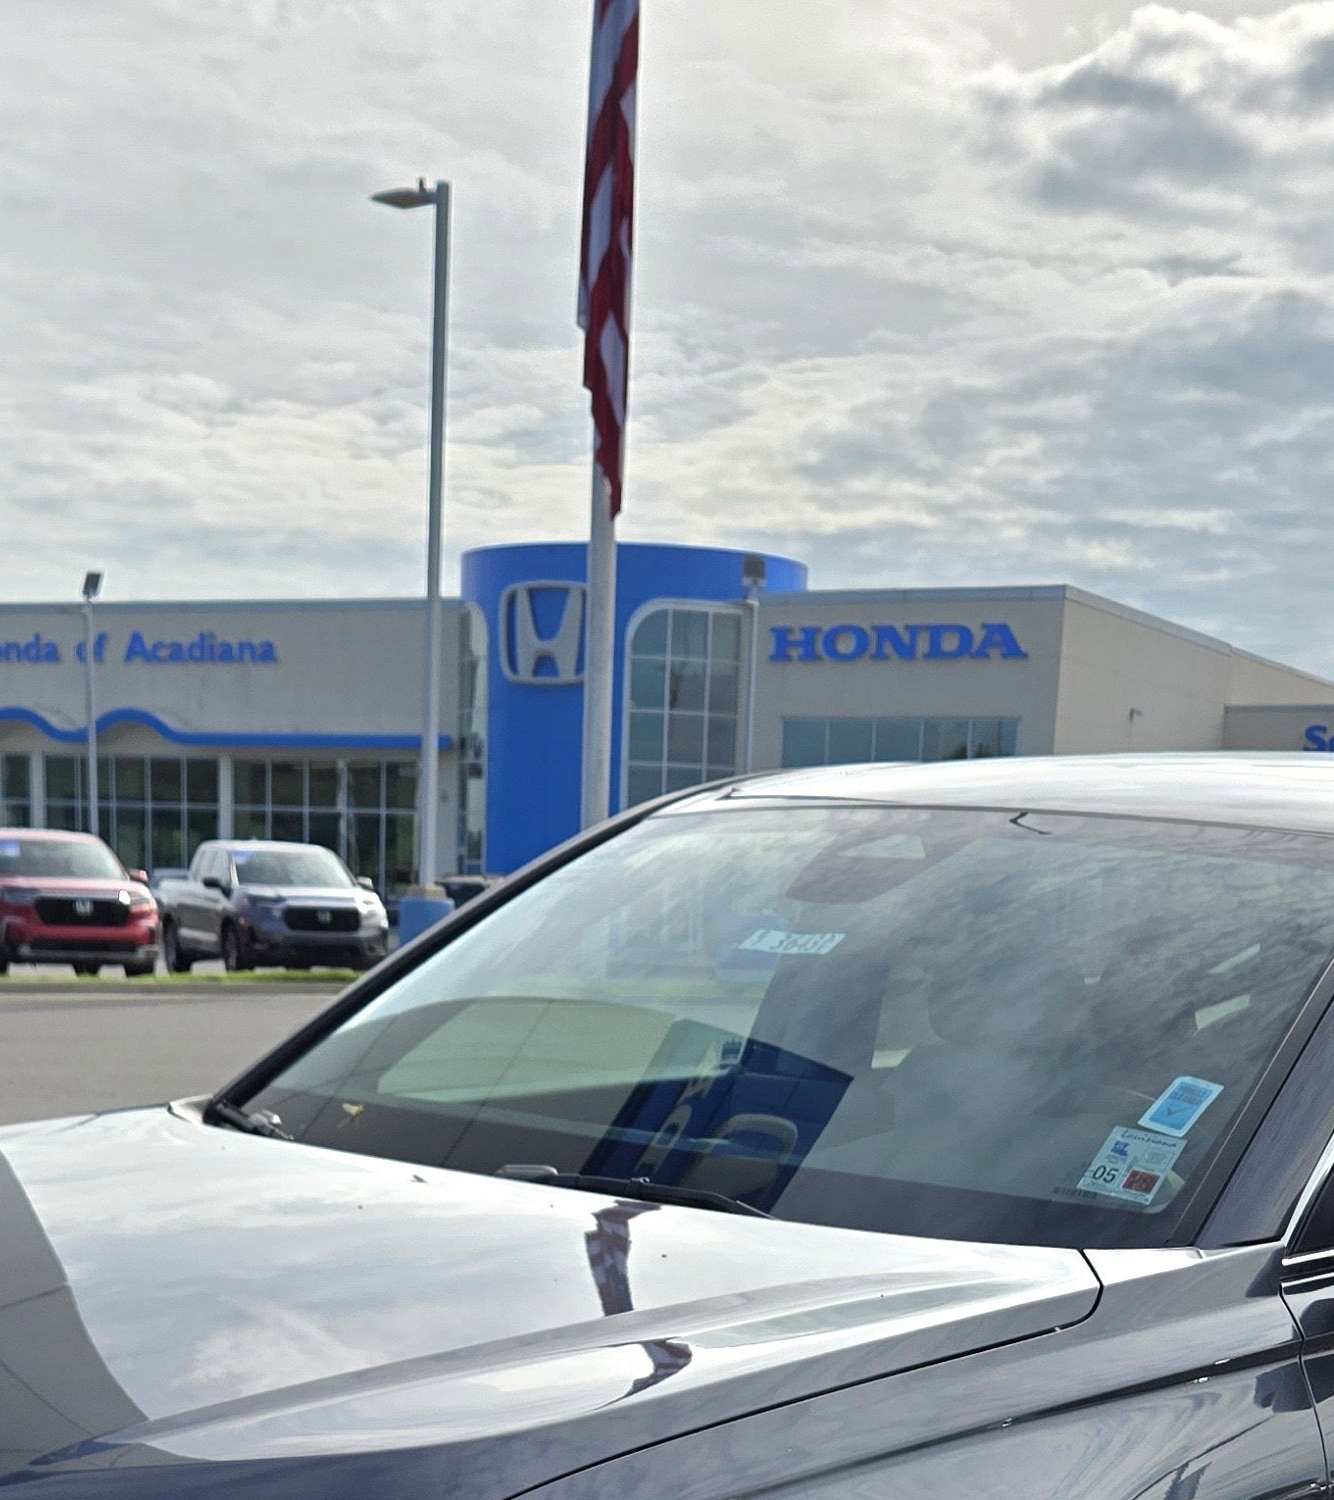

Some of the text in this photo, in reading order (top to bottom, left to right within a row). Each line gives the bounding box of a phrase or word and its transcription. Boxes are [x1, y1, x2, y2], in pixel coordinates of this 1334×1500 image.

[124, 631, 278, 665] Acadiana
[769, 623, 1029, 662] HONDA
[1092, 1164, 1120, 1184] 05
